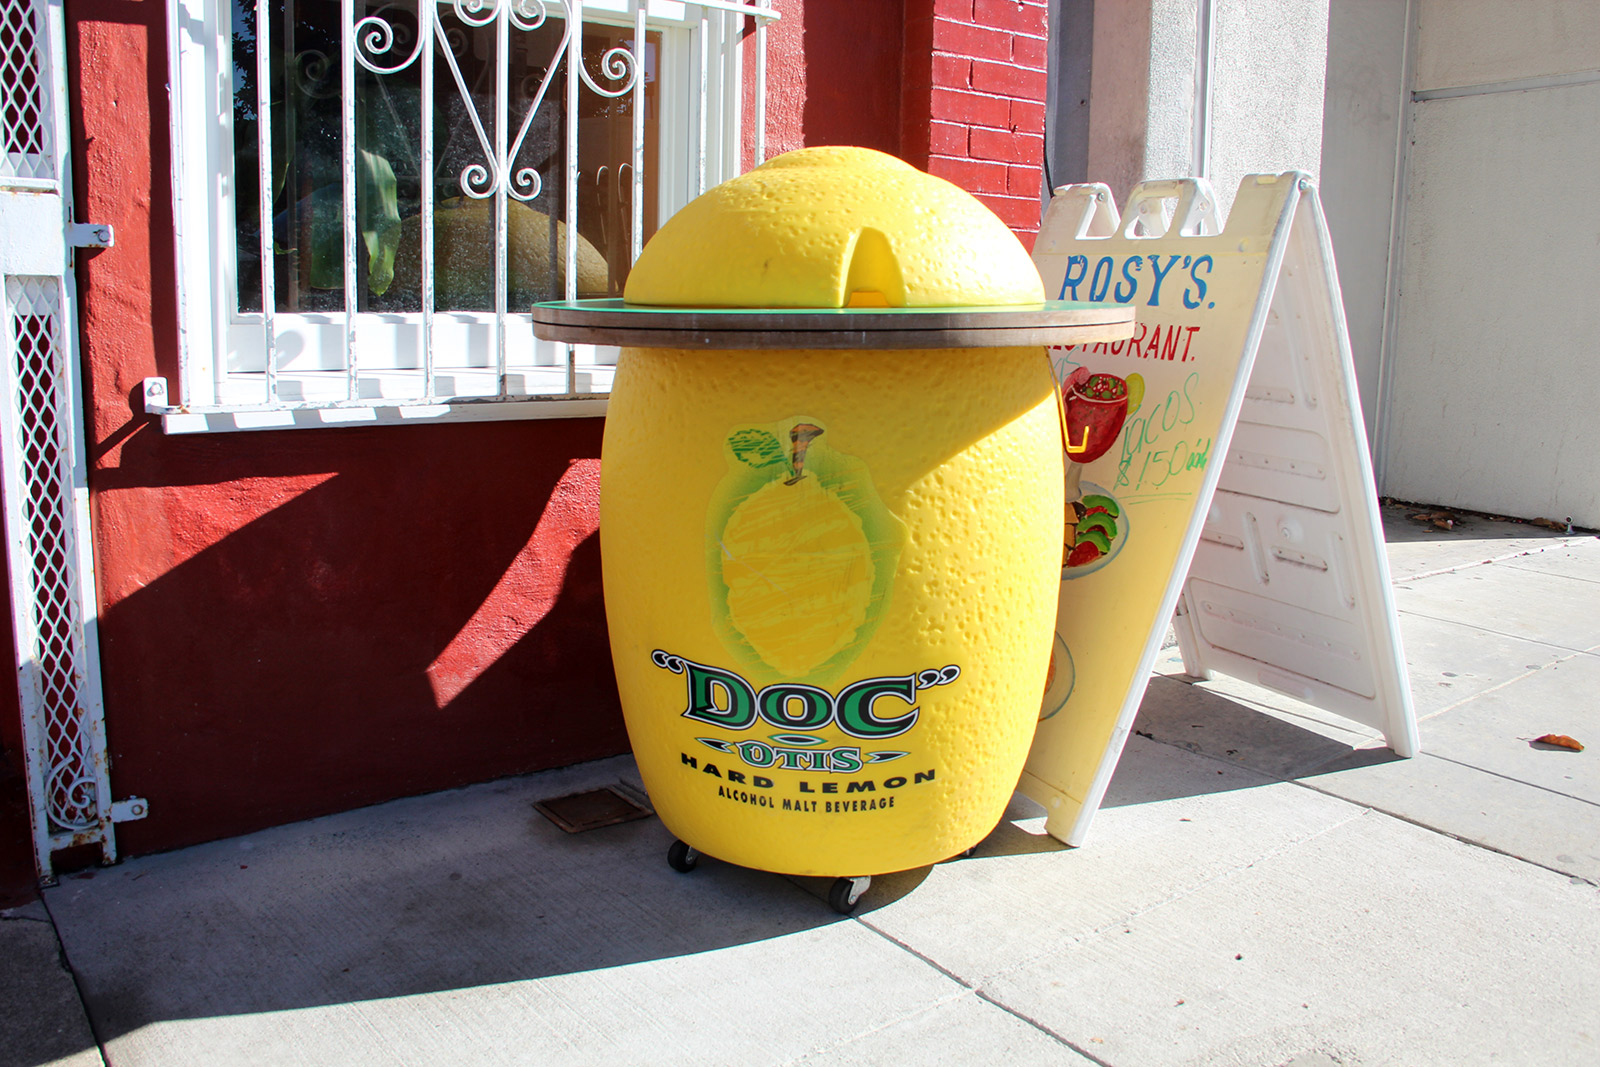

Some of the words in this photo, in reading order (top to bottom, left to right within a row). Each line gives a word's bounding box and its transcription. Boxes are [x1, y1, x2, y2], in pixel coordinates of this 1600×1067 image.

[1048, 321, 1201, 362] URANT.
[681, 752, 775, 789] HARD
[799, 768, 936, 794] LEMON
[734, 740, 863, 774] OTIS
[717, 785, 775, 809] ALCOHOL
[782, 798, 818, 813] MALT
[825, 796, 896, 813] BEVERAGE
